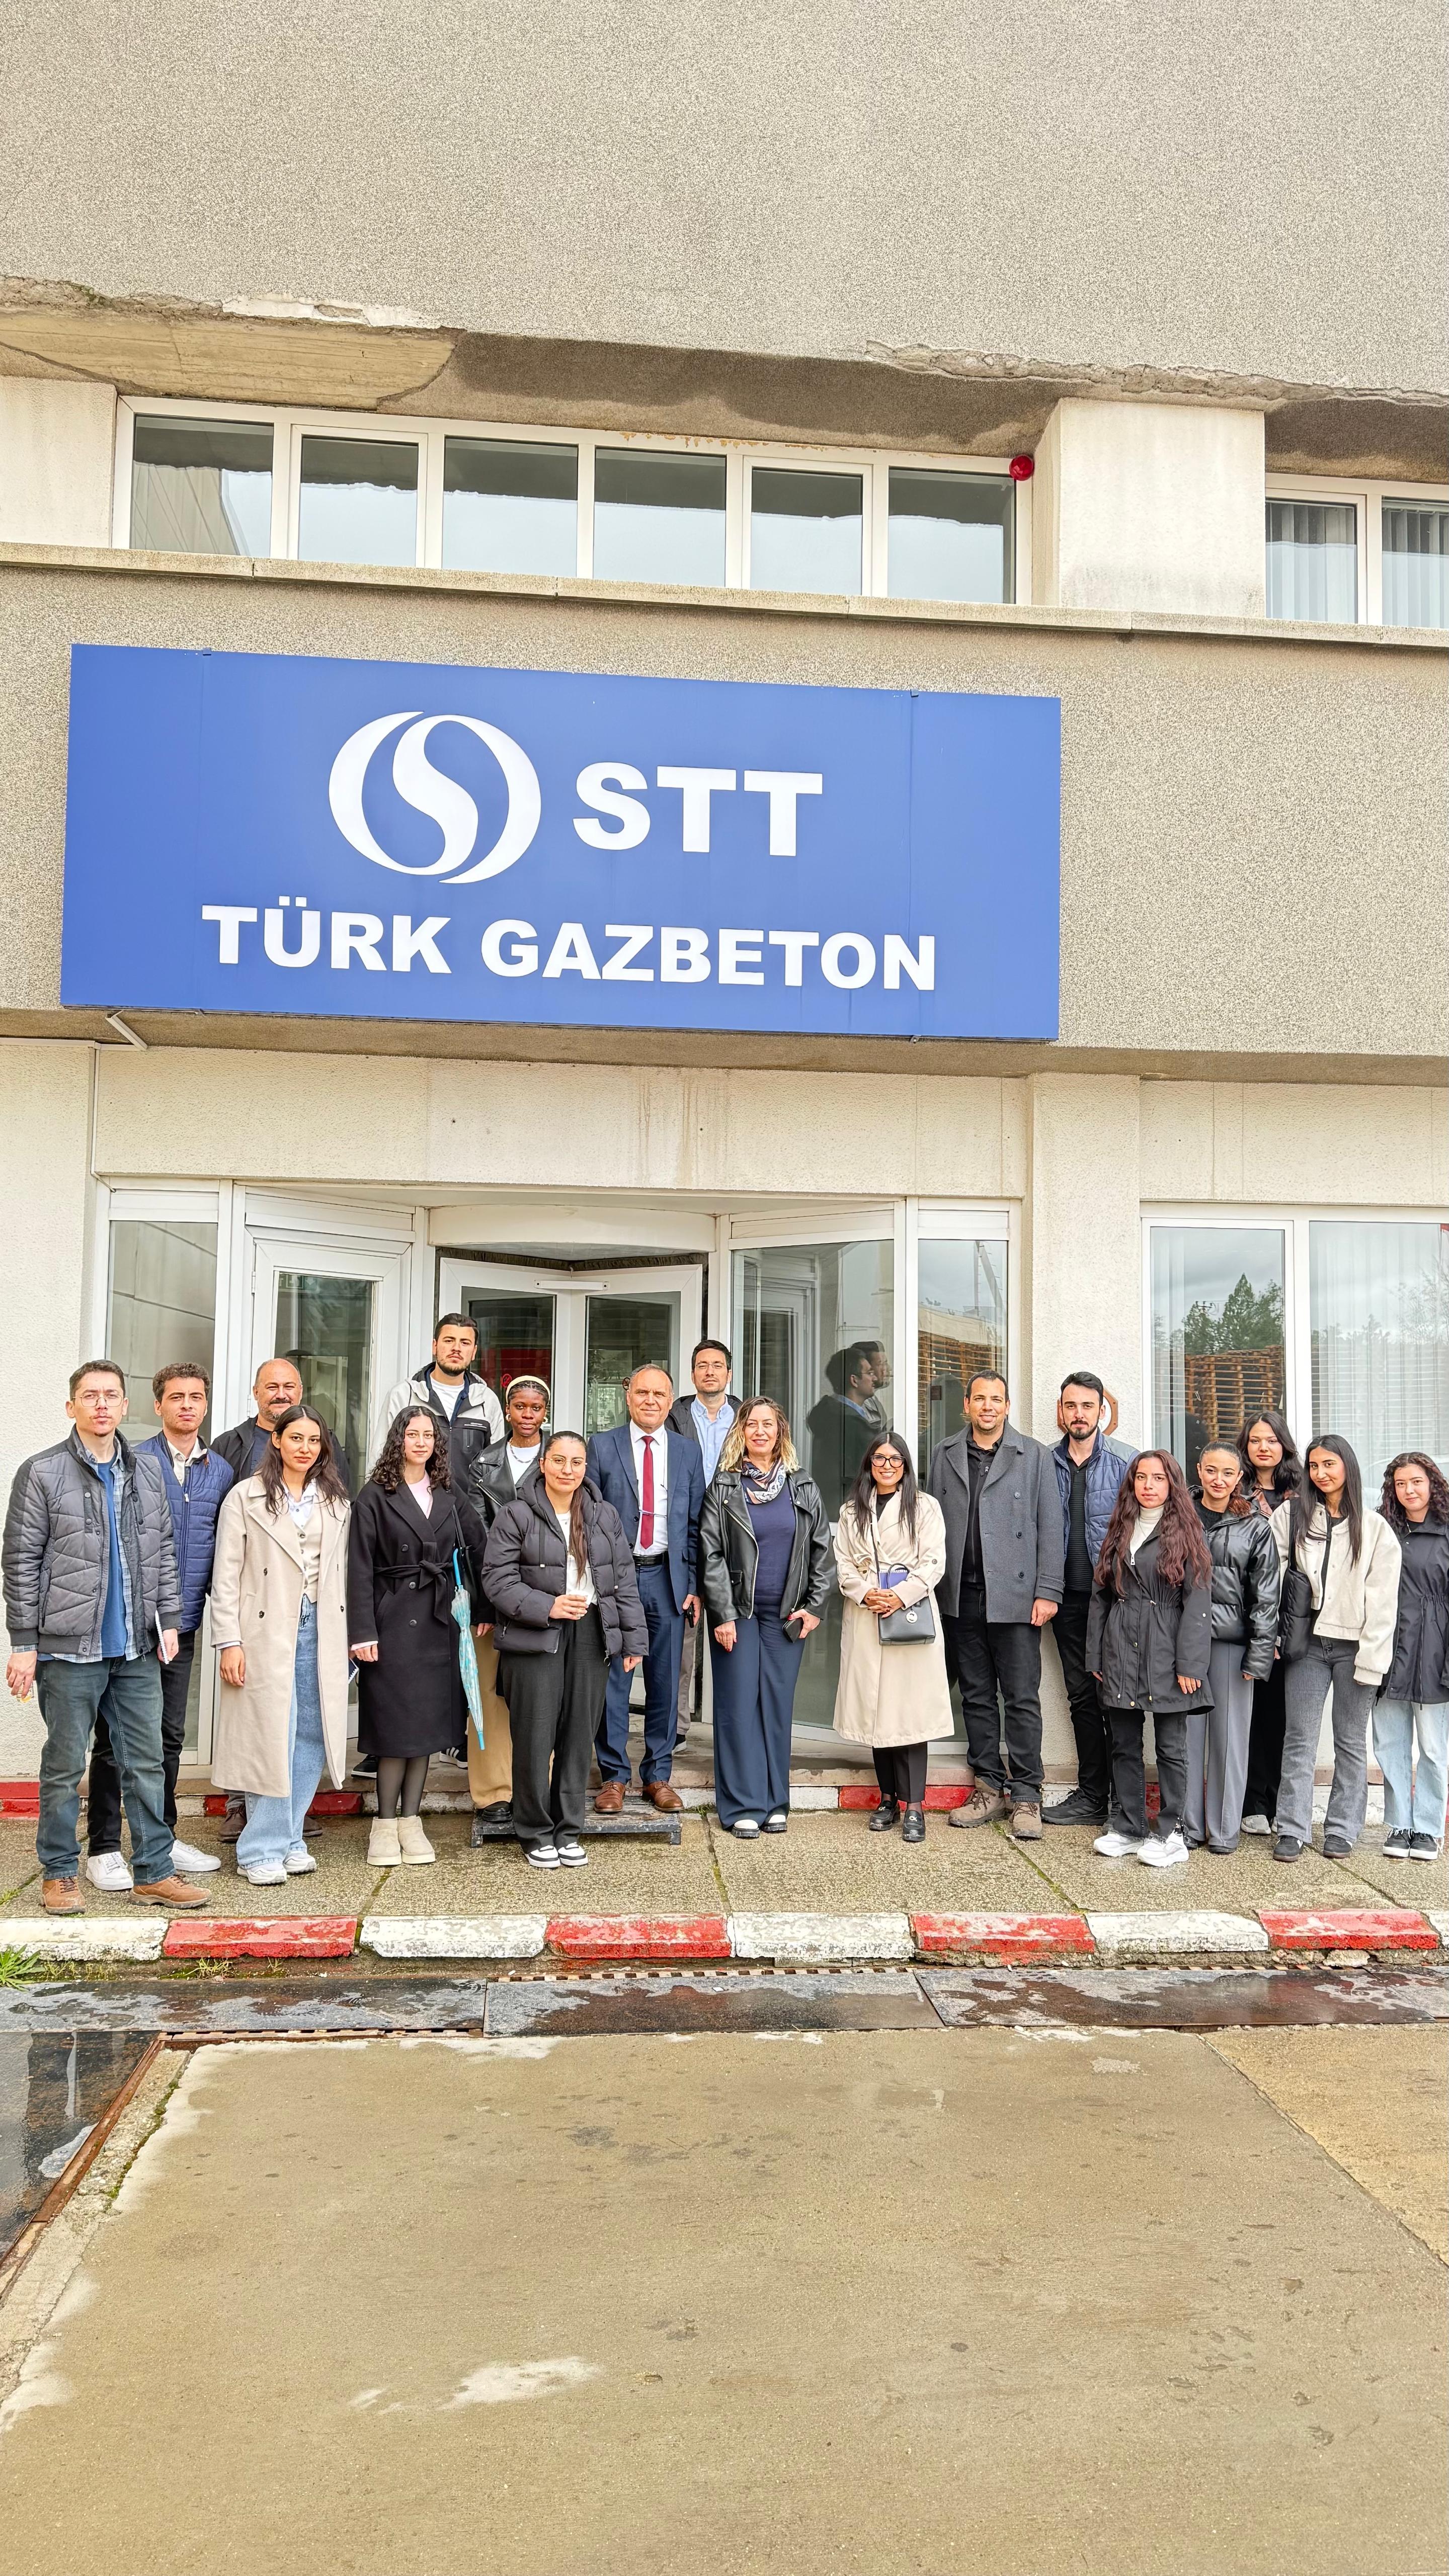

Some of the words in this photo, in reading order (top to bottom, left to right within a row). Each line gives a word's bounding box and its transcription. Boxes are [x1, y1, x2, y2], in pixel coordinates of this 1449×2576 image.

[573, 762, 823, 857] STT
[202, 896, 452, 974] TÜRK
[481, 919, 935, 991] GAZBETON
